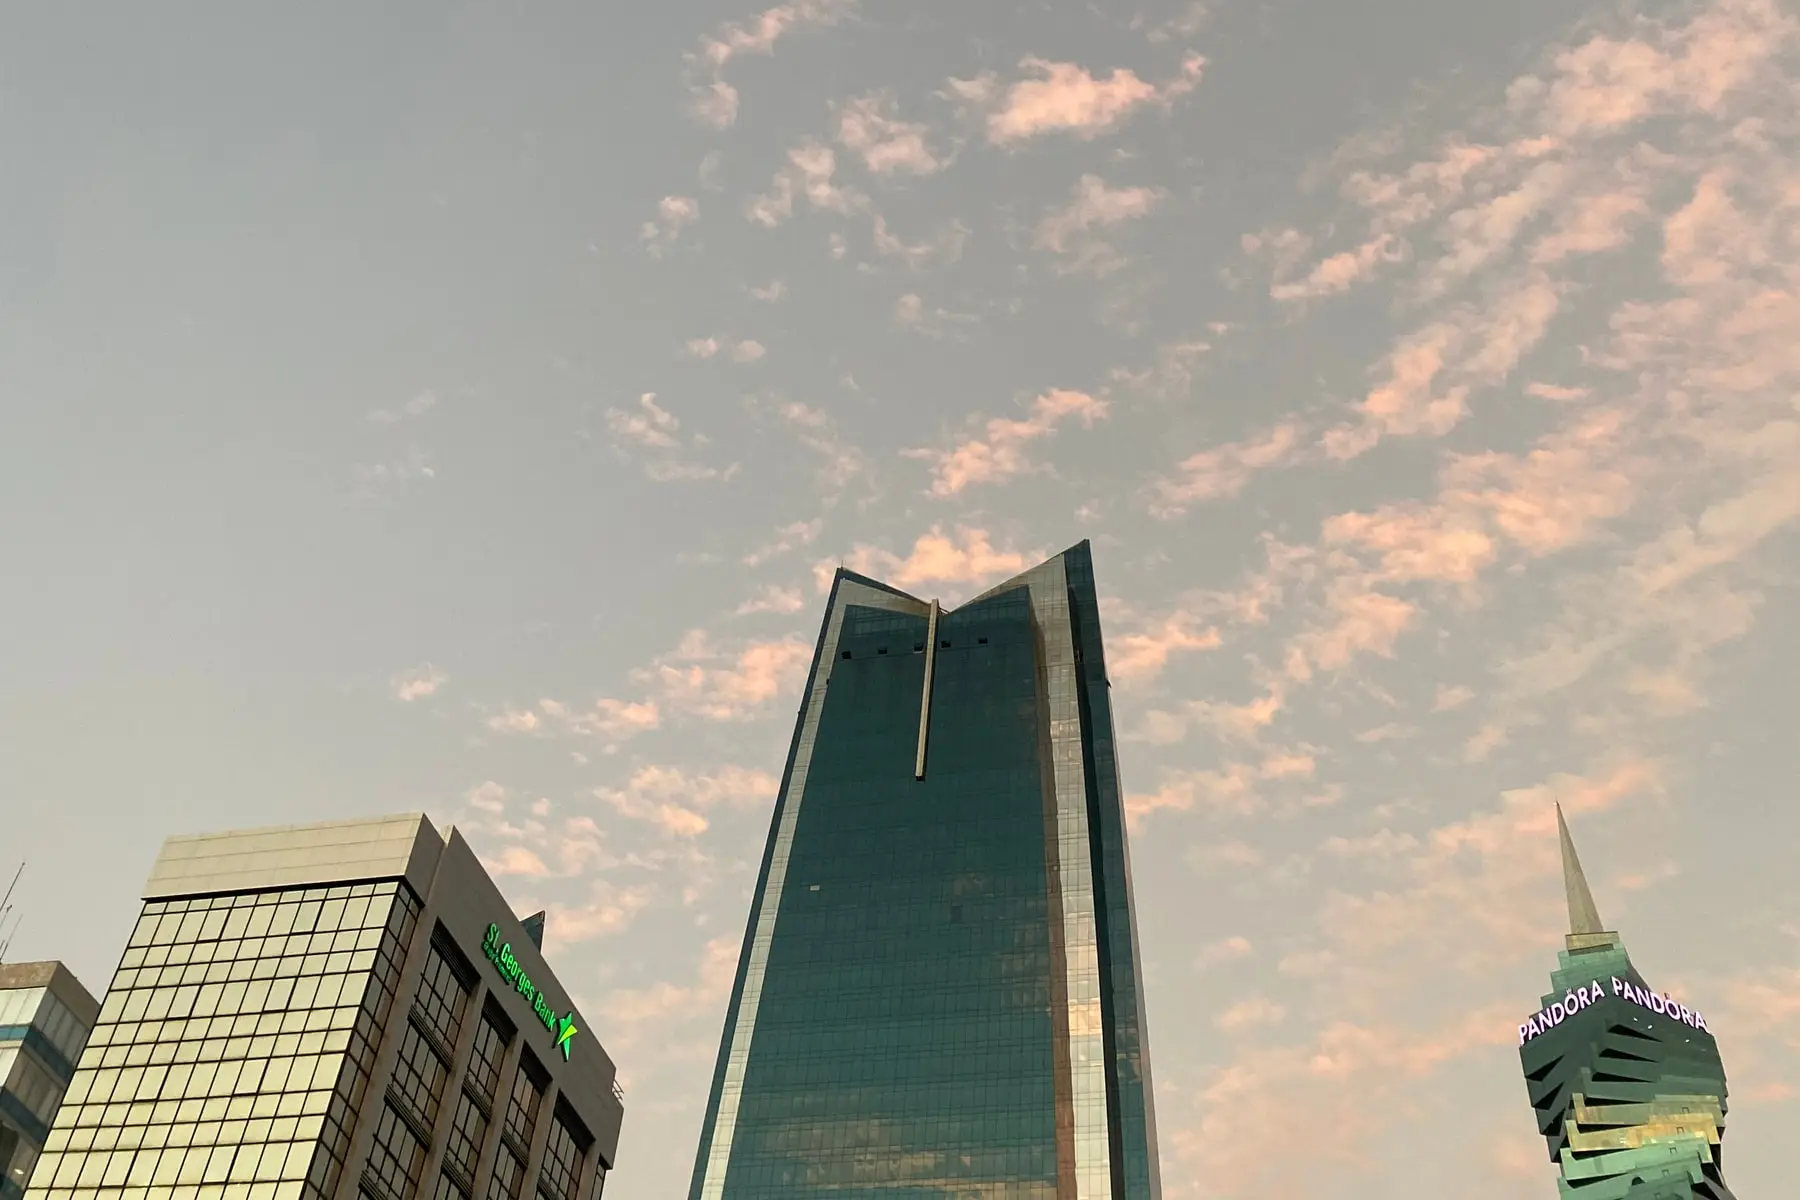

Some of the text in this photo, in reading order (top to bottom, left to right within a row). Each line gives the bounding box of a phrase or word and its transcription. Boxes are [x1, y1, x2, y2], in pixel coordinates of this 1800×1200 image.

[501, 943, 535, 1001] Georges
[534, 991, 557, 1032] Bank
[1518, 979, 1605, 1045] PANDORA
[1611, 976, 1709, 1033] PANDORA
